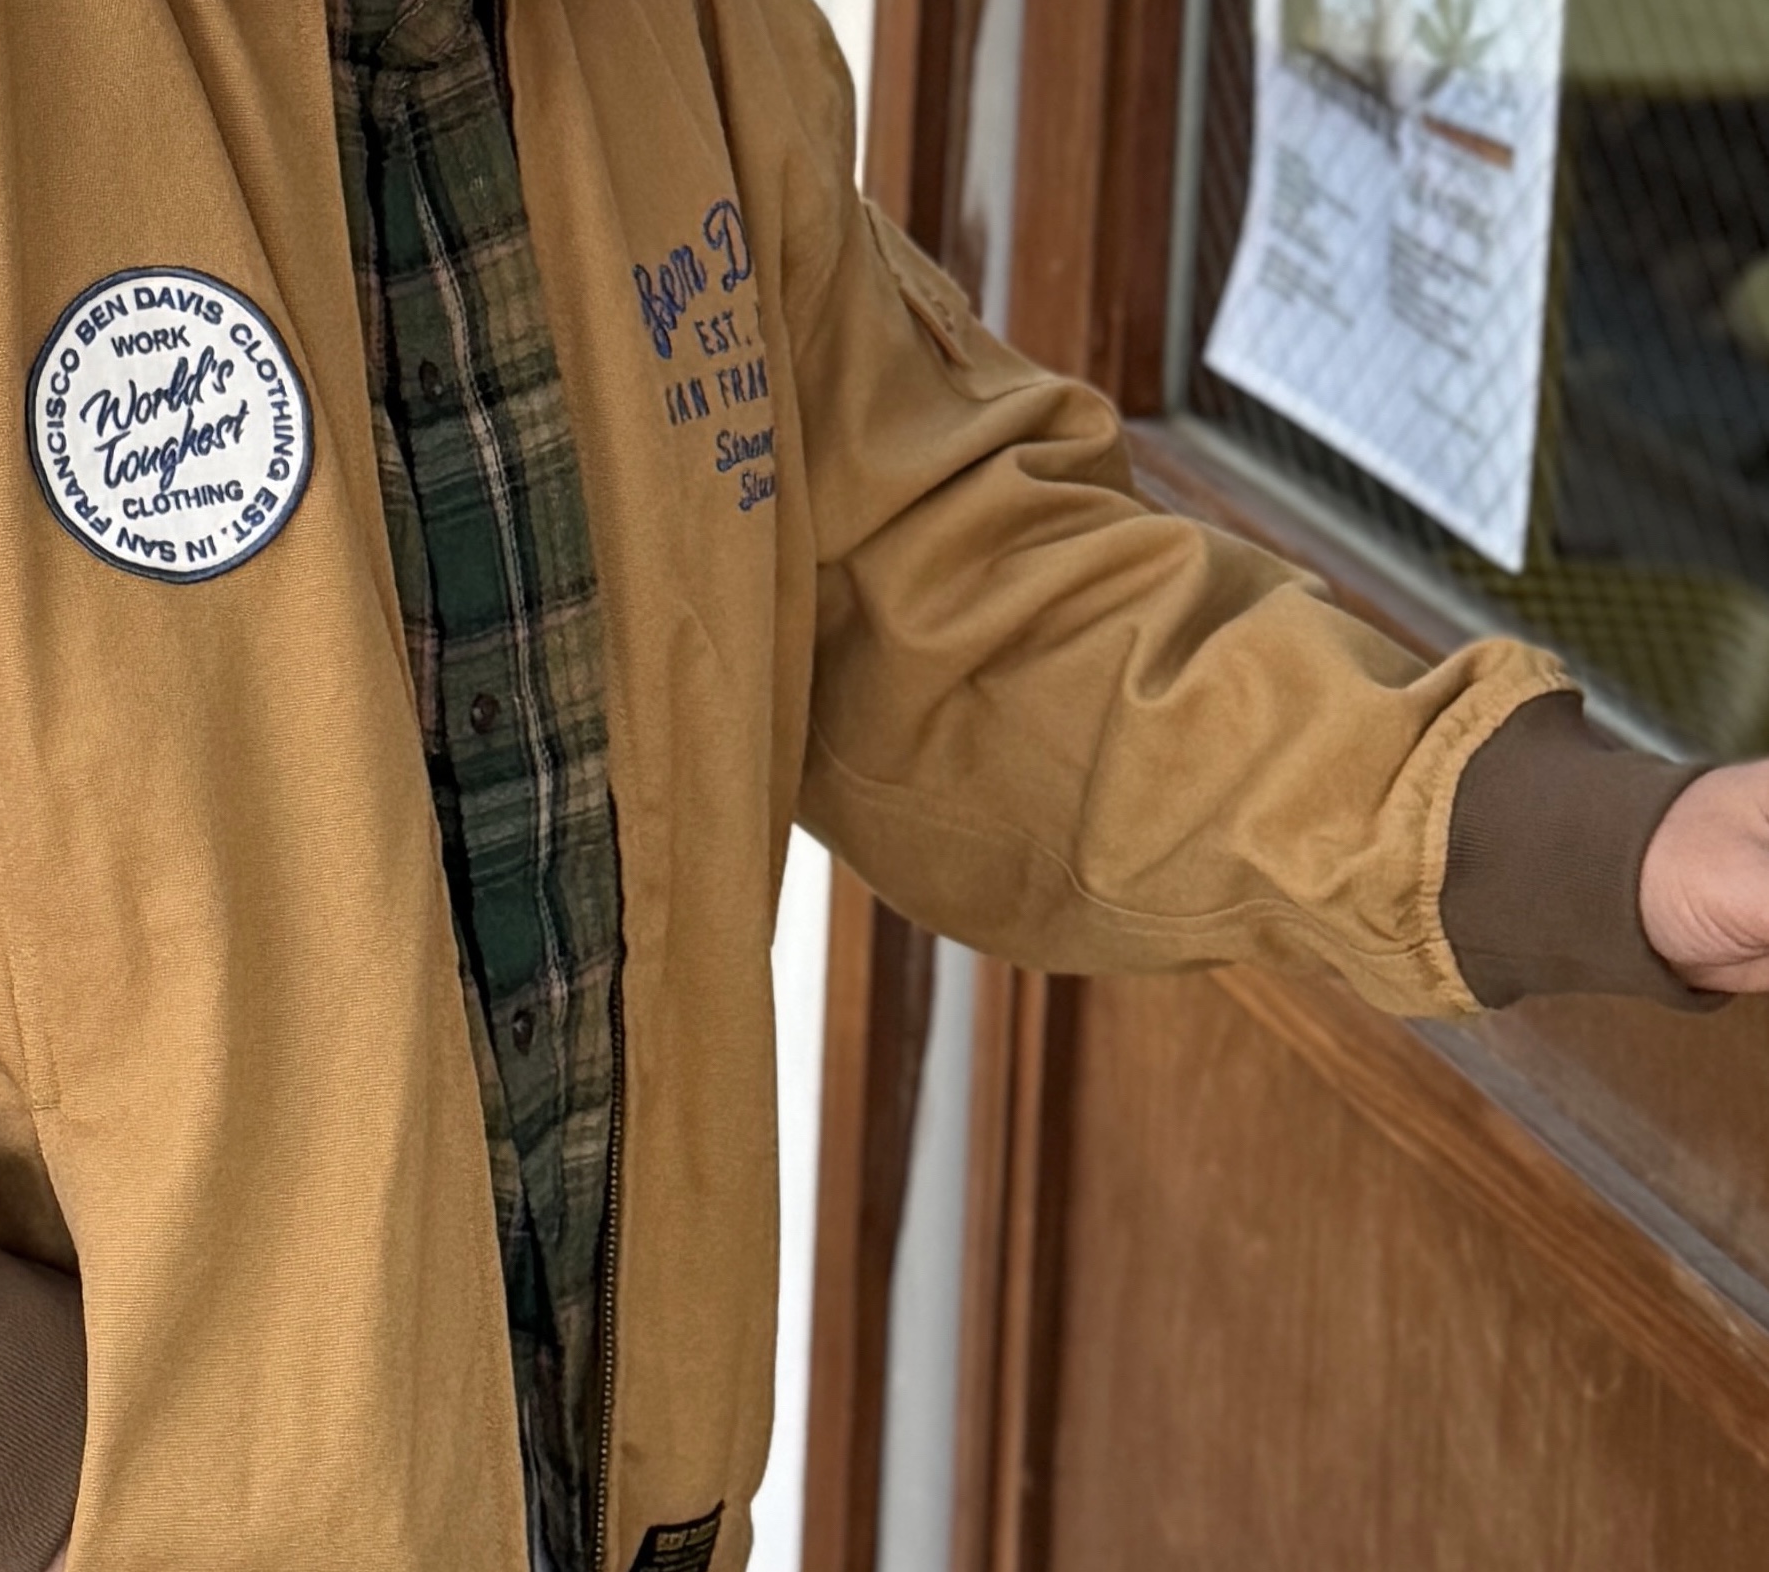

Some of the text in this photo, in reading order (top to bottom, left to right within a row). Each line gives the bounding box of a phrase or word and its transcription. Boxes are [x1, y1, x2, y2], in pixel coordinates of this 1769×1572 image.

[702, 199, 752, 293] D
[75, 294, 129, 346] BEN
[134, 286, 224, 325] DAVIS
[111, 325, 191, 358] WORK
[79, 345, 235, 437] World's
[229, 323, 296, 481] CLOTHING
[717, 355, 769, 410] FRAN
[46, 347, 113, 536] FRANCISCO
[94, 399, 250, 491] Toughest
[122, 479, 245, 520] CLOTHING
[117, 527, 177, 563] SAN
[187, 535, 218, 563] IN
